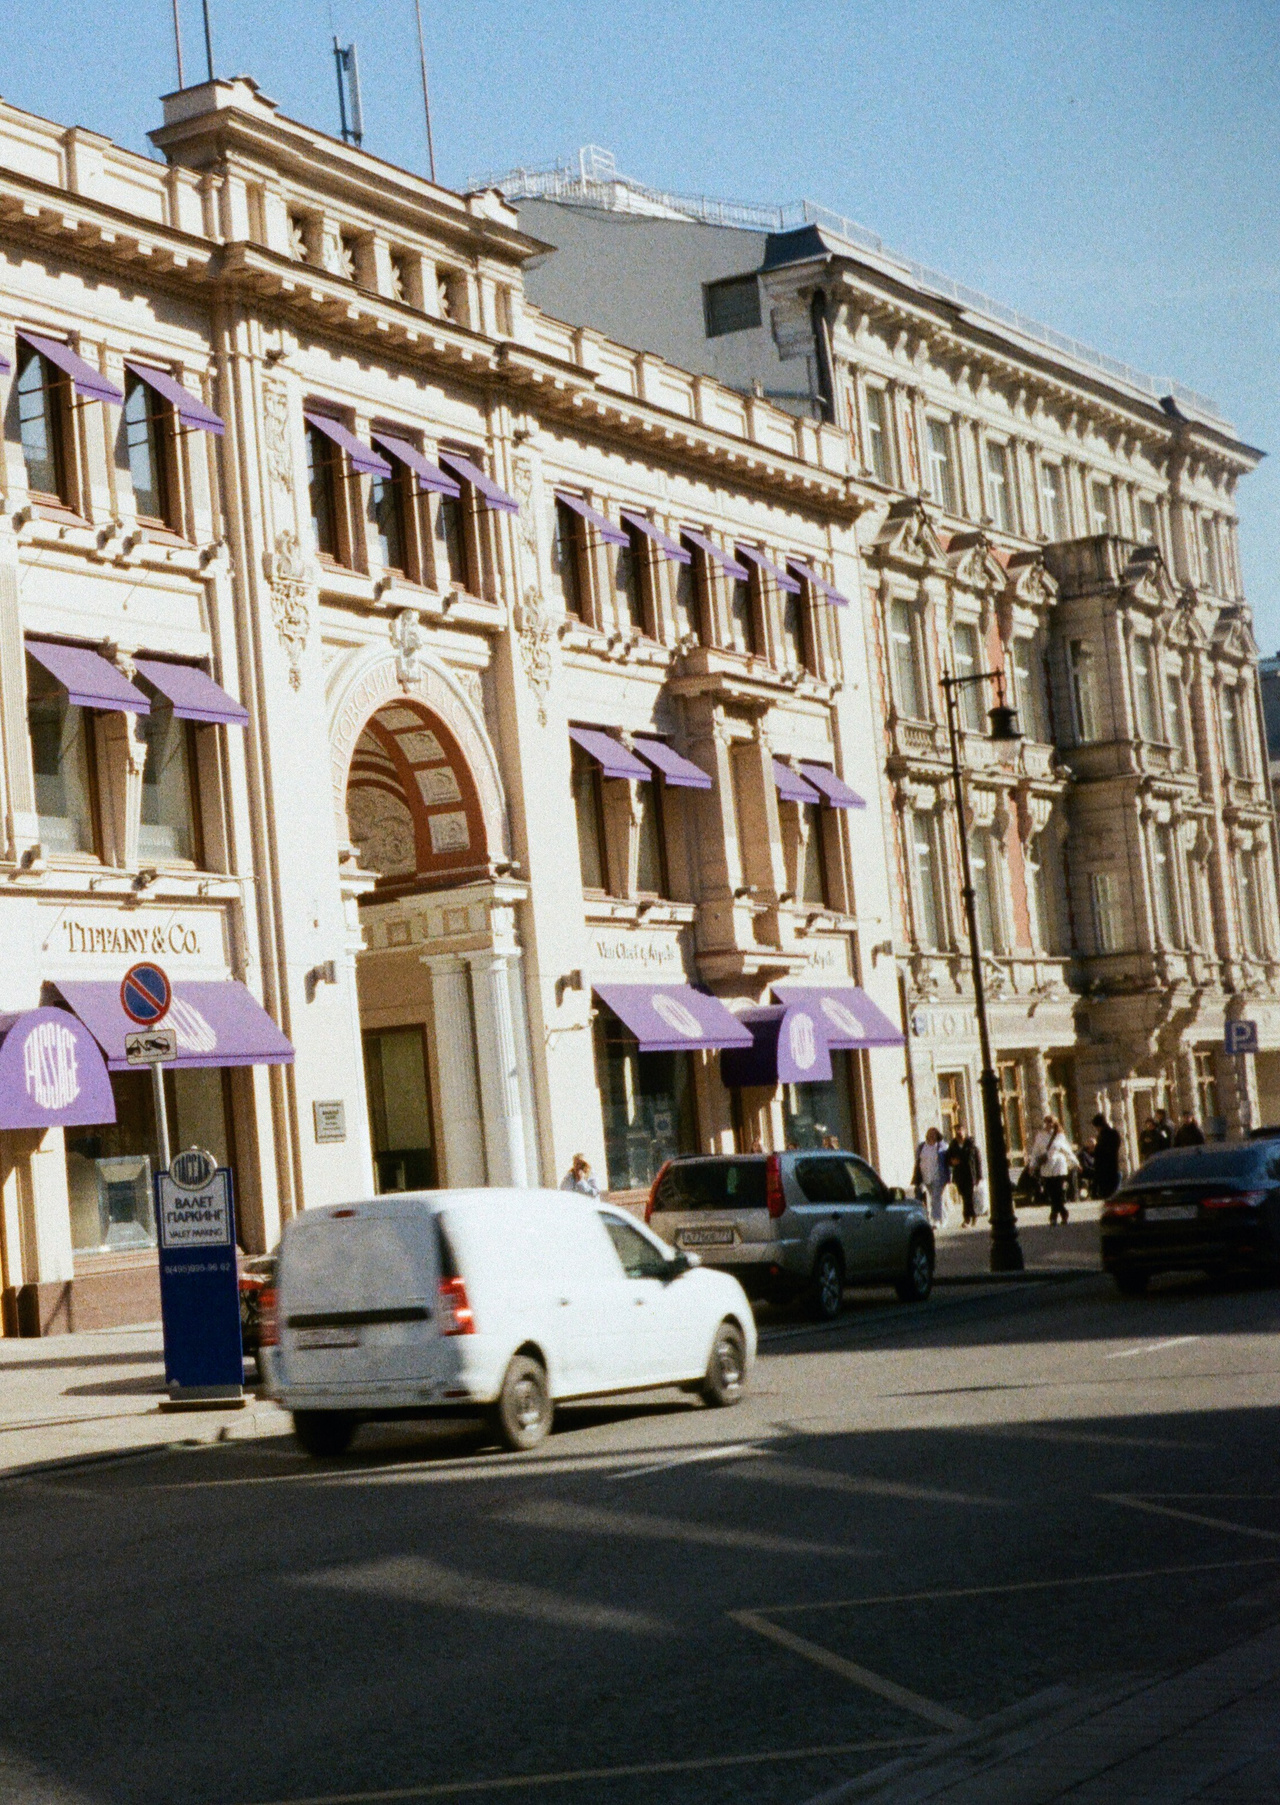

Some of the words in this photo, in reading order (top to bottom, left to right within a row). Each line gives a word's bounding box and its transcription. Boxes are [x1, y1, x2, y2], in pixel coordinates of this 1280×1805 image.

[174, 1195, 214, 1210] ВАЛЕТ
[167, 1209, 224, 1223] ПАРКИНГ
[169, 1229, 191, 1239] VALET
[192, 1227, 223, 1238] PARKING
